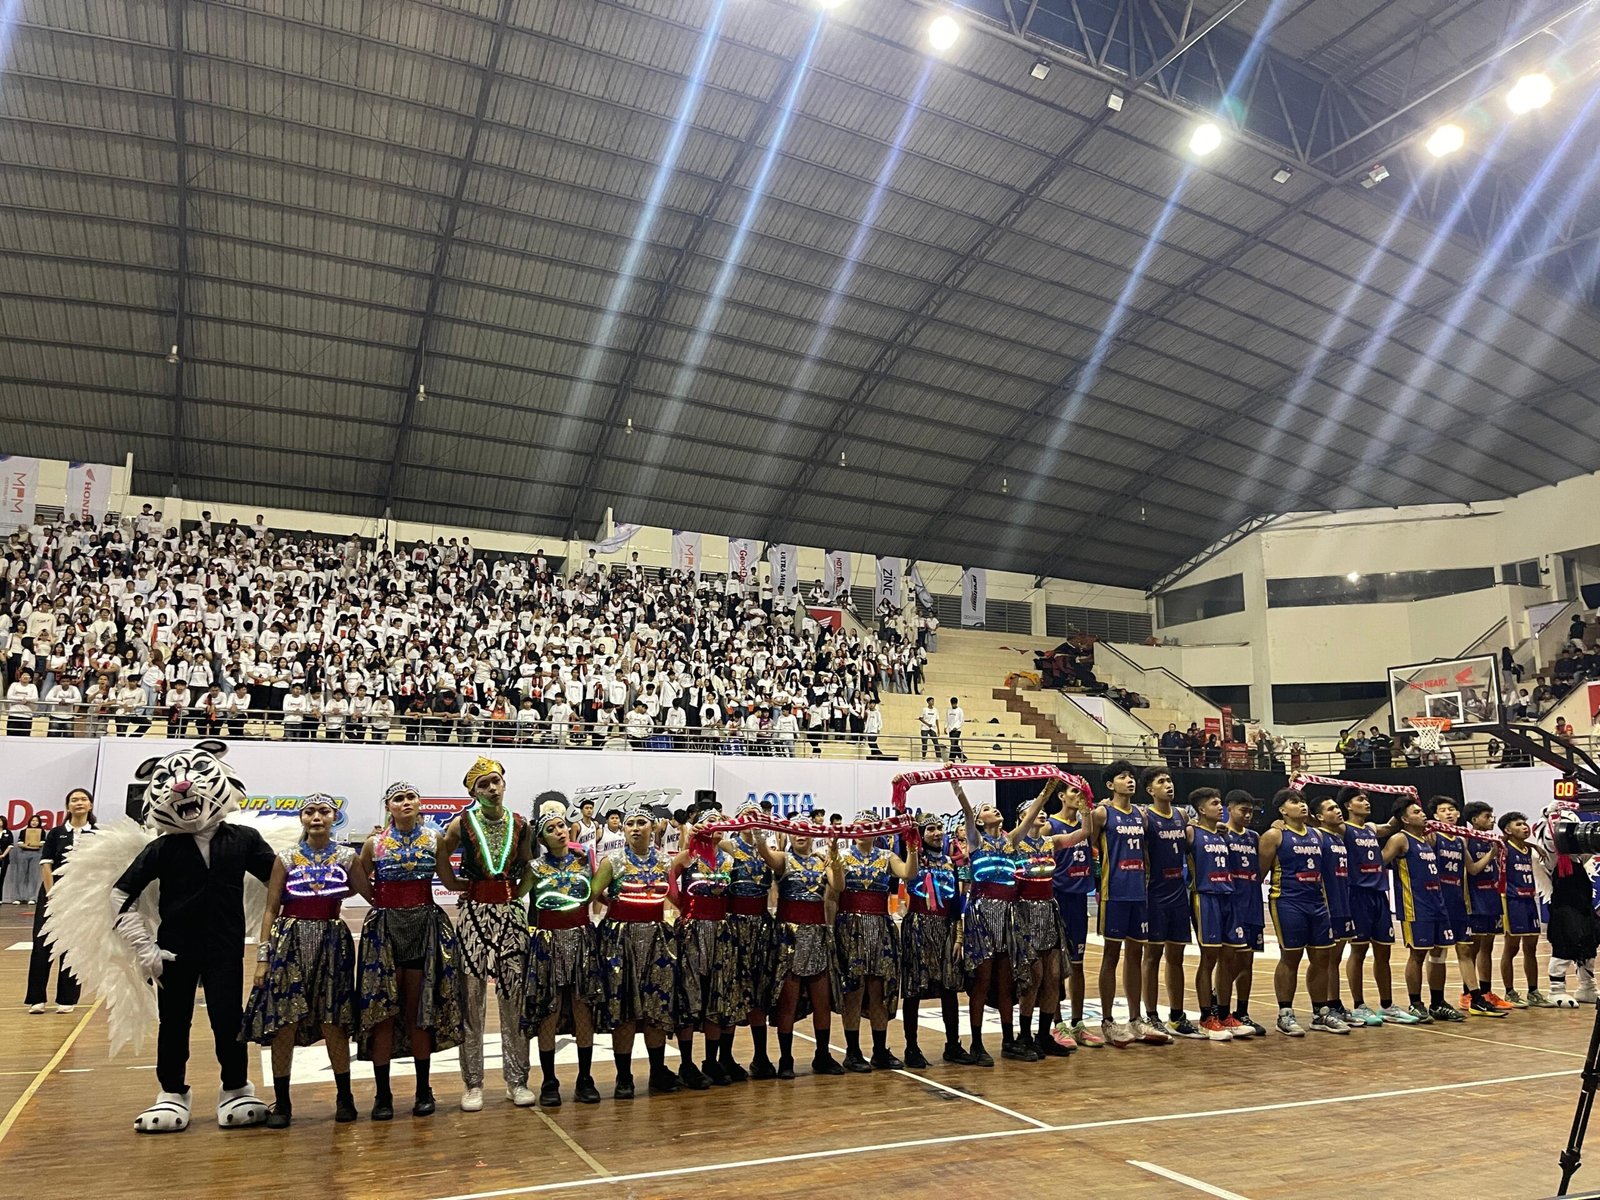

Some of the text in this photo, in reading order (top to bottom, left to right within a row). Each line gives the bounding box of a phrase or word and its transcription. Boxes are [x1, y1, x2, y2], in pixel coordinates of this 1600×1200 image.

[10, 472, 26, 513] MPM
[919, 765, 1070, 781] MITREKA SATATA
[1556, 782, 1574, 797] 00
[565, 787, 683, 823] STREET
[745, 790, 814, 819] AQUA
[8, 800, 67, 831] Da
[1173, 842, 1179, 854] 1
[1367, 851, 1375, 860] 0
[1241, 856, 1250, 868] 3
[1307, 858, 1315, 869] 8
